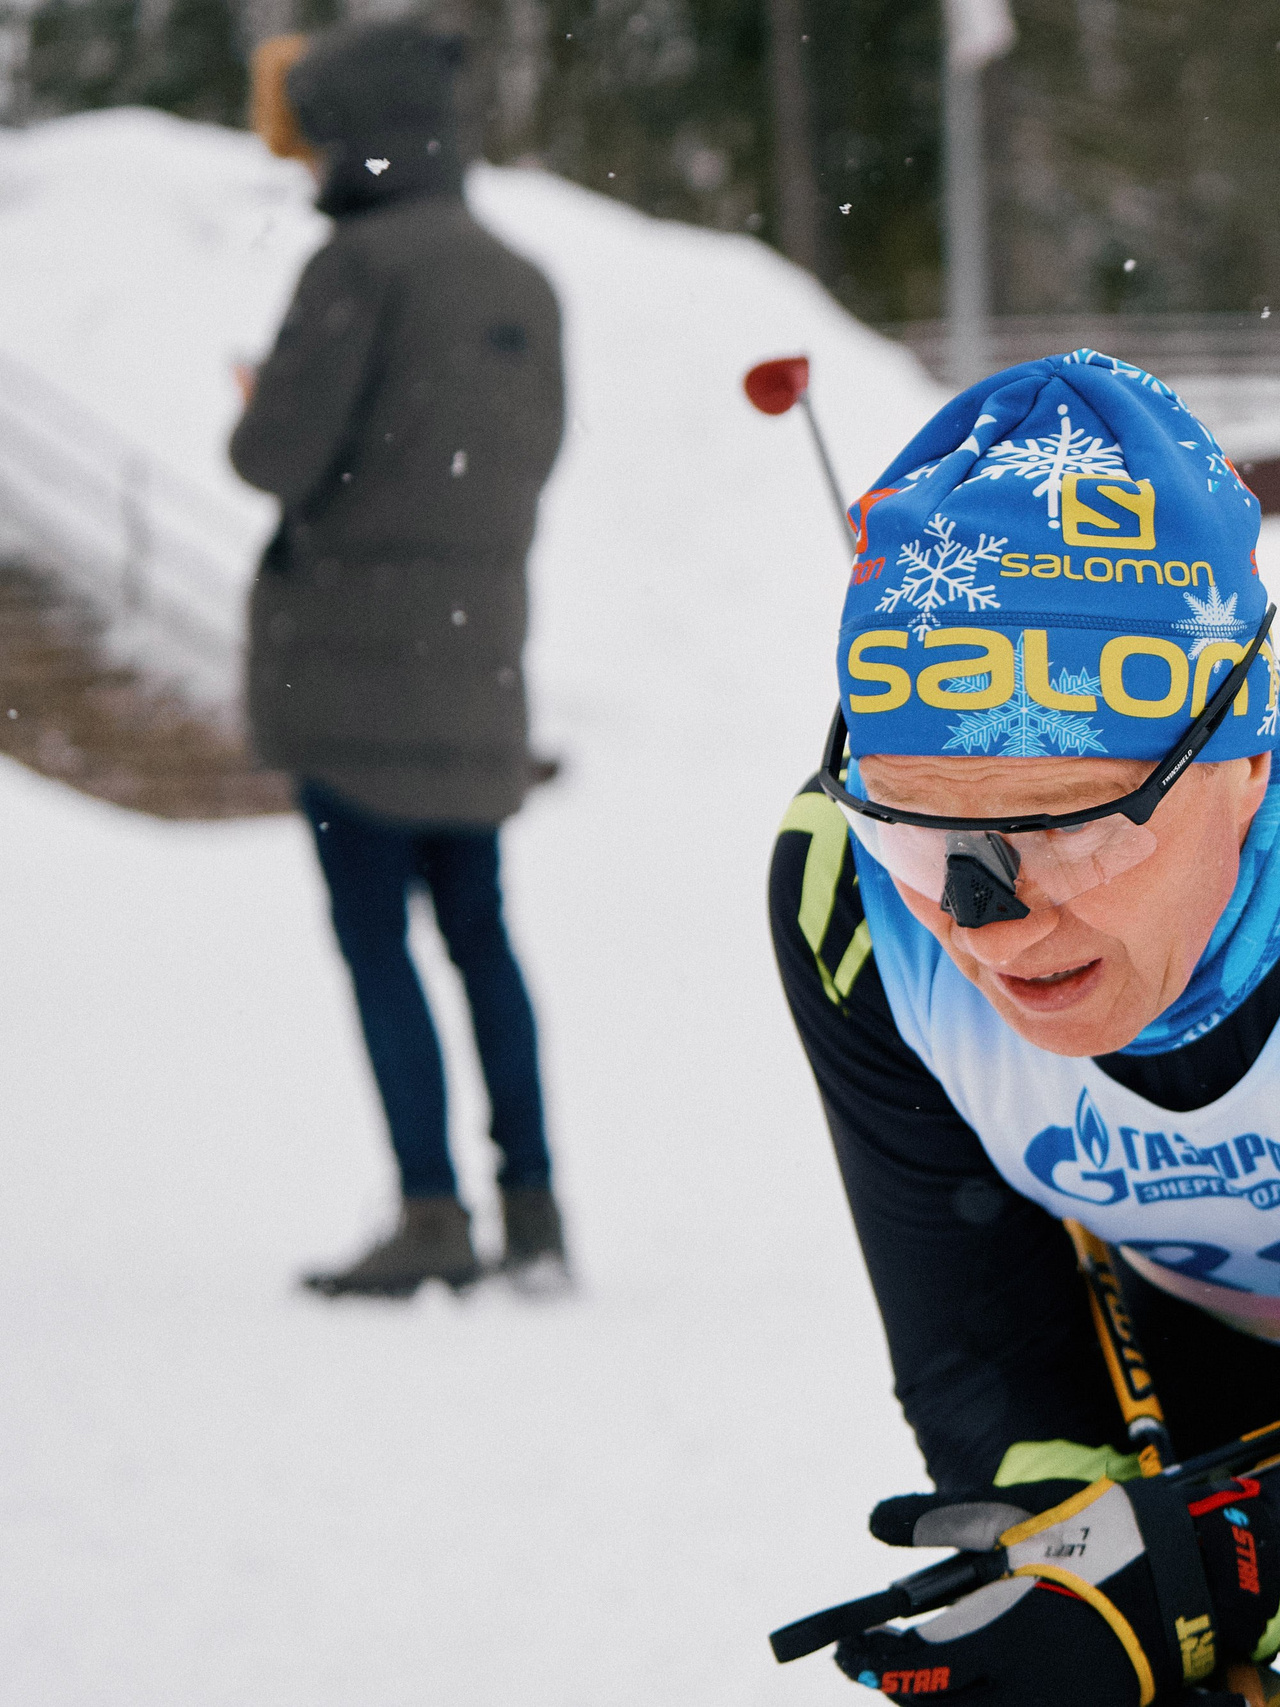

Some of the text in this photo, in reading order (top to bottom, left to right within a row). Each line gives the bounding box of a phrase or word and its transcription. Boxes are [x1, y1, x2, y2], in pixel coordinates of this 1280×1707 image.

[1161, 748, 1193, 787] TWINSHIELD
[1231, 1524, 1261, 1595] STAR
[881, 1665, 952, 1695] STAR
